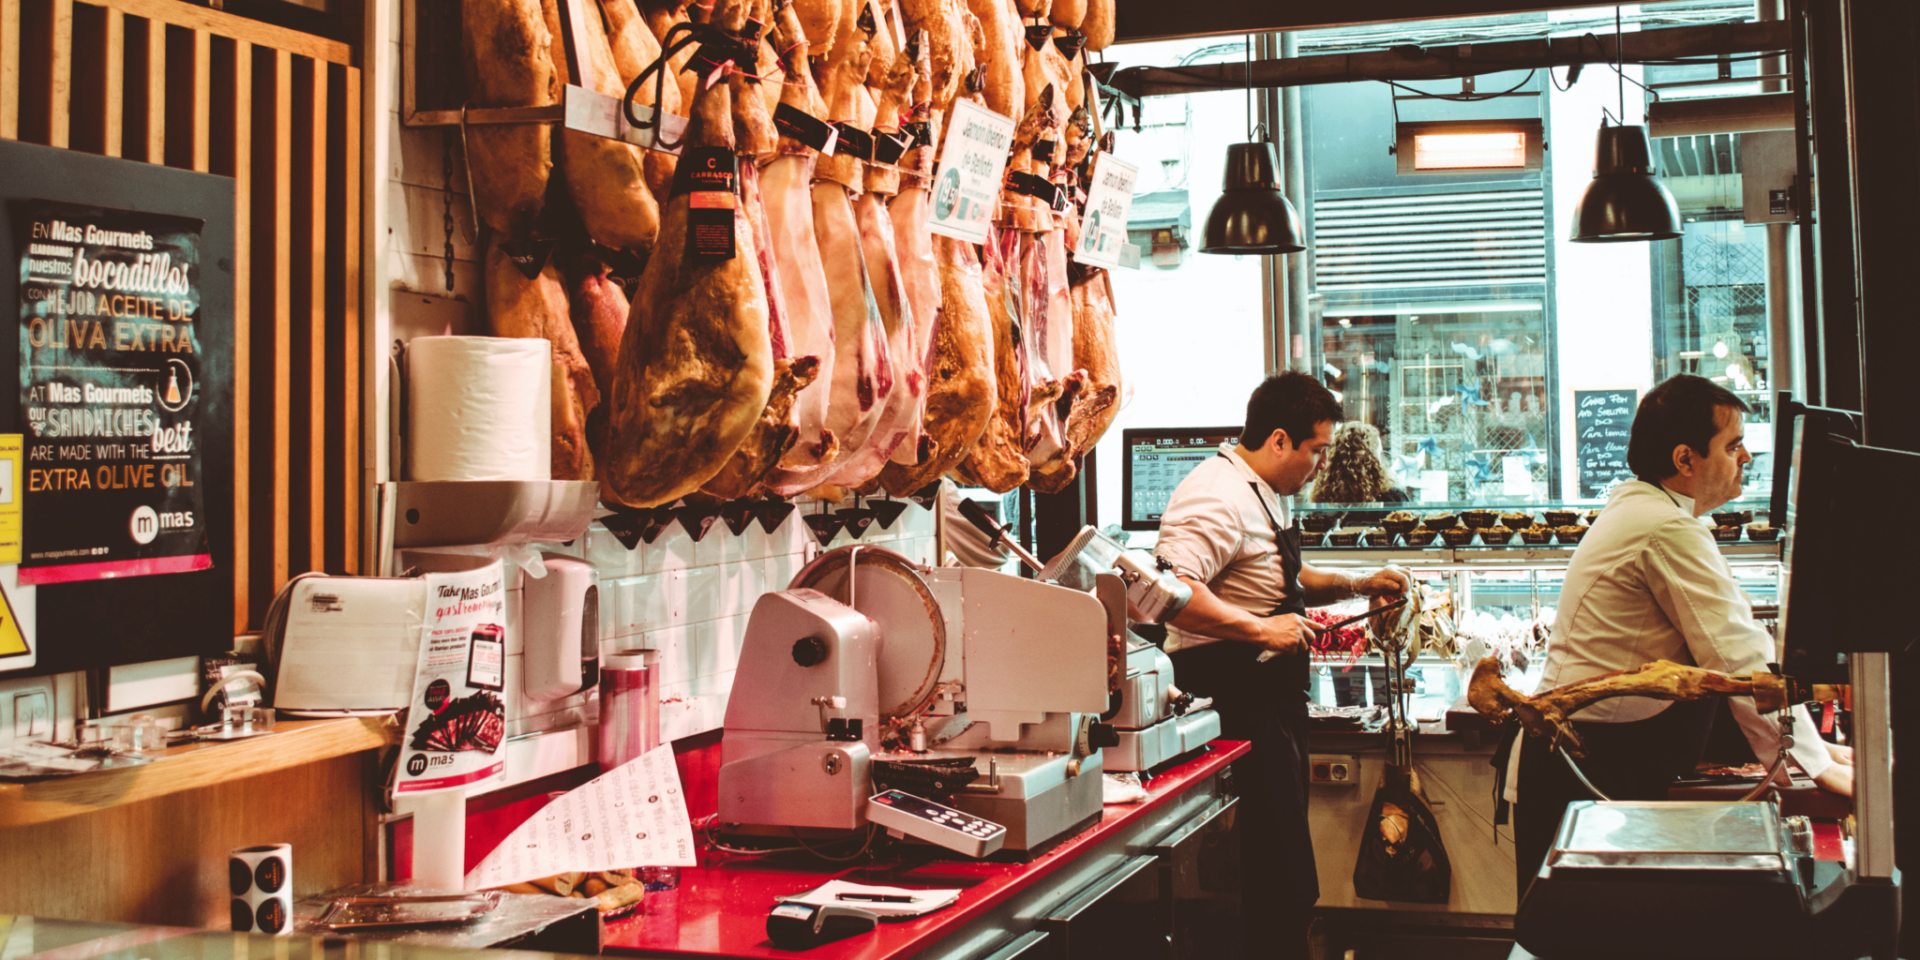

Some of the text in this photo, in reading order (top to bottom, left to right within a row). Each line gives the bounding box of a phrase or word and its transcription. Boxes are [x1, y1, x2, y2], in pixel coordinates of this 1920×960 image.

[707, 158, 716, 169] C
[691, 171, 733, 179] CARRASCO
[32, 220, 154, 250] EN Mas Gourmets
[29, 259, 72, 275] nuestros
[74, 247, 189, 295] bocadillos
[28, 288, 193, 322] CON MEJOR ACEITE DE
[29, 318, 193, 353] OLIVA EXTRA
[30, 382, 153, 403] AT Mas Gourmets
[29, 407, 154, 437] our SANDWICHES
[1577, 409, 1592, 418] AND
[152, 418, 193, 453] best
[30, 444, 150, 460] ARE MADE WITH THE
[30, 463, 194, 491] EXTRA OLIVE OIL
[160, 510, 194, 528] mas
[438, 585, 461, 598] Take
[460, 586, 479, 601] Mas
[430, 754, 454, 766] mas
[676, 838, 687, 858] mas
